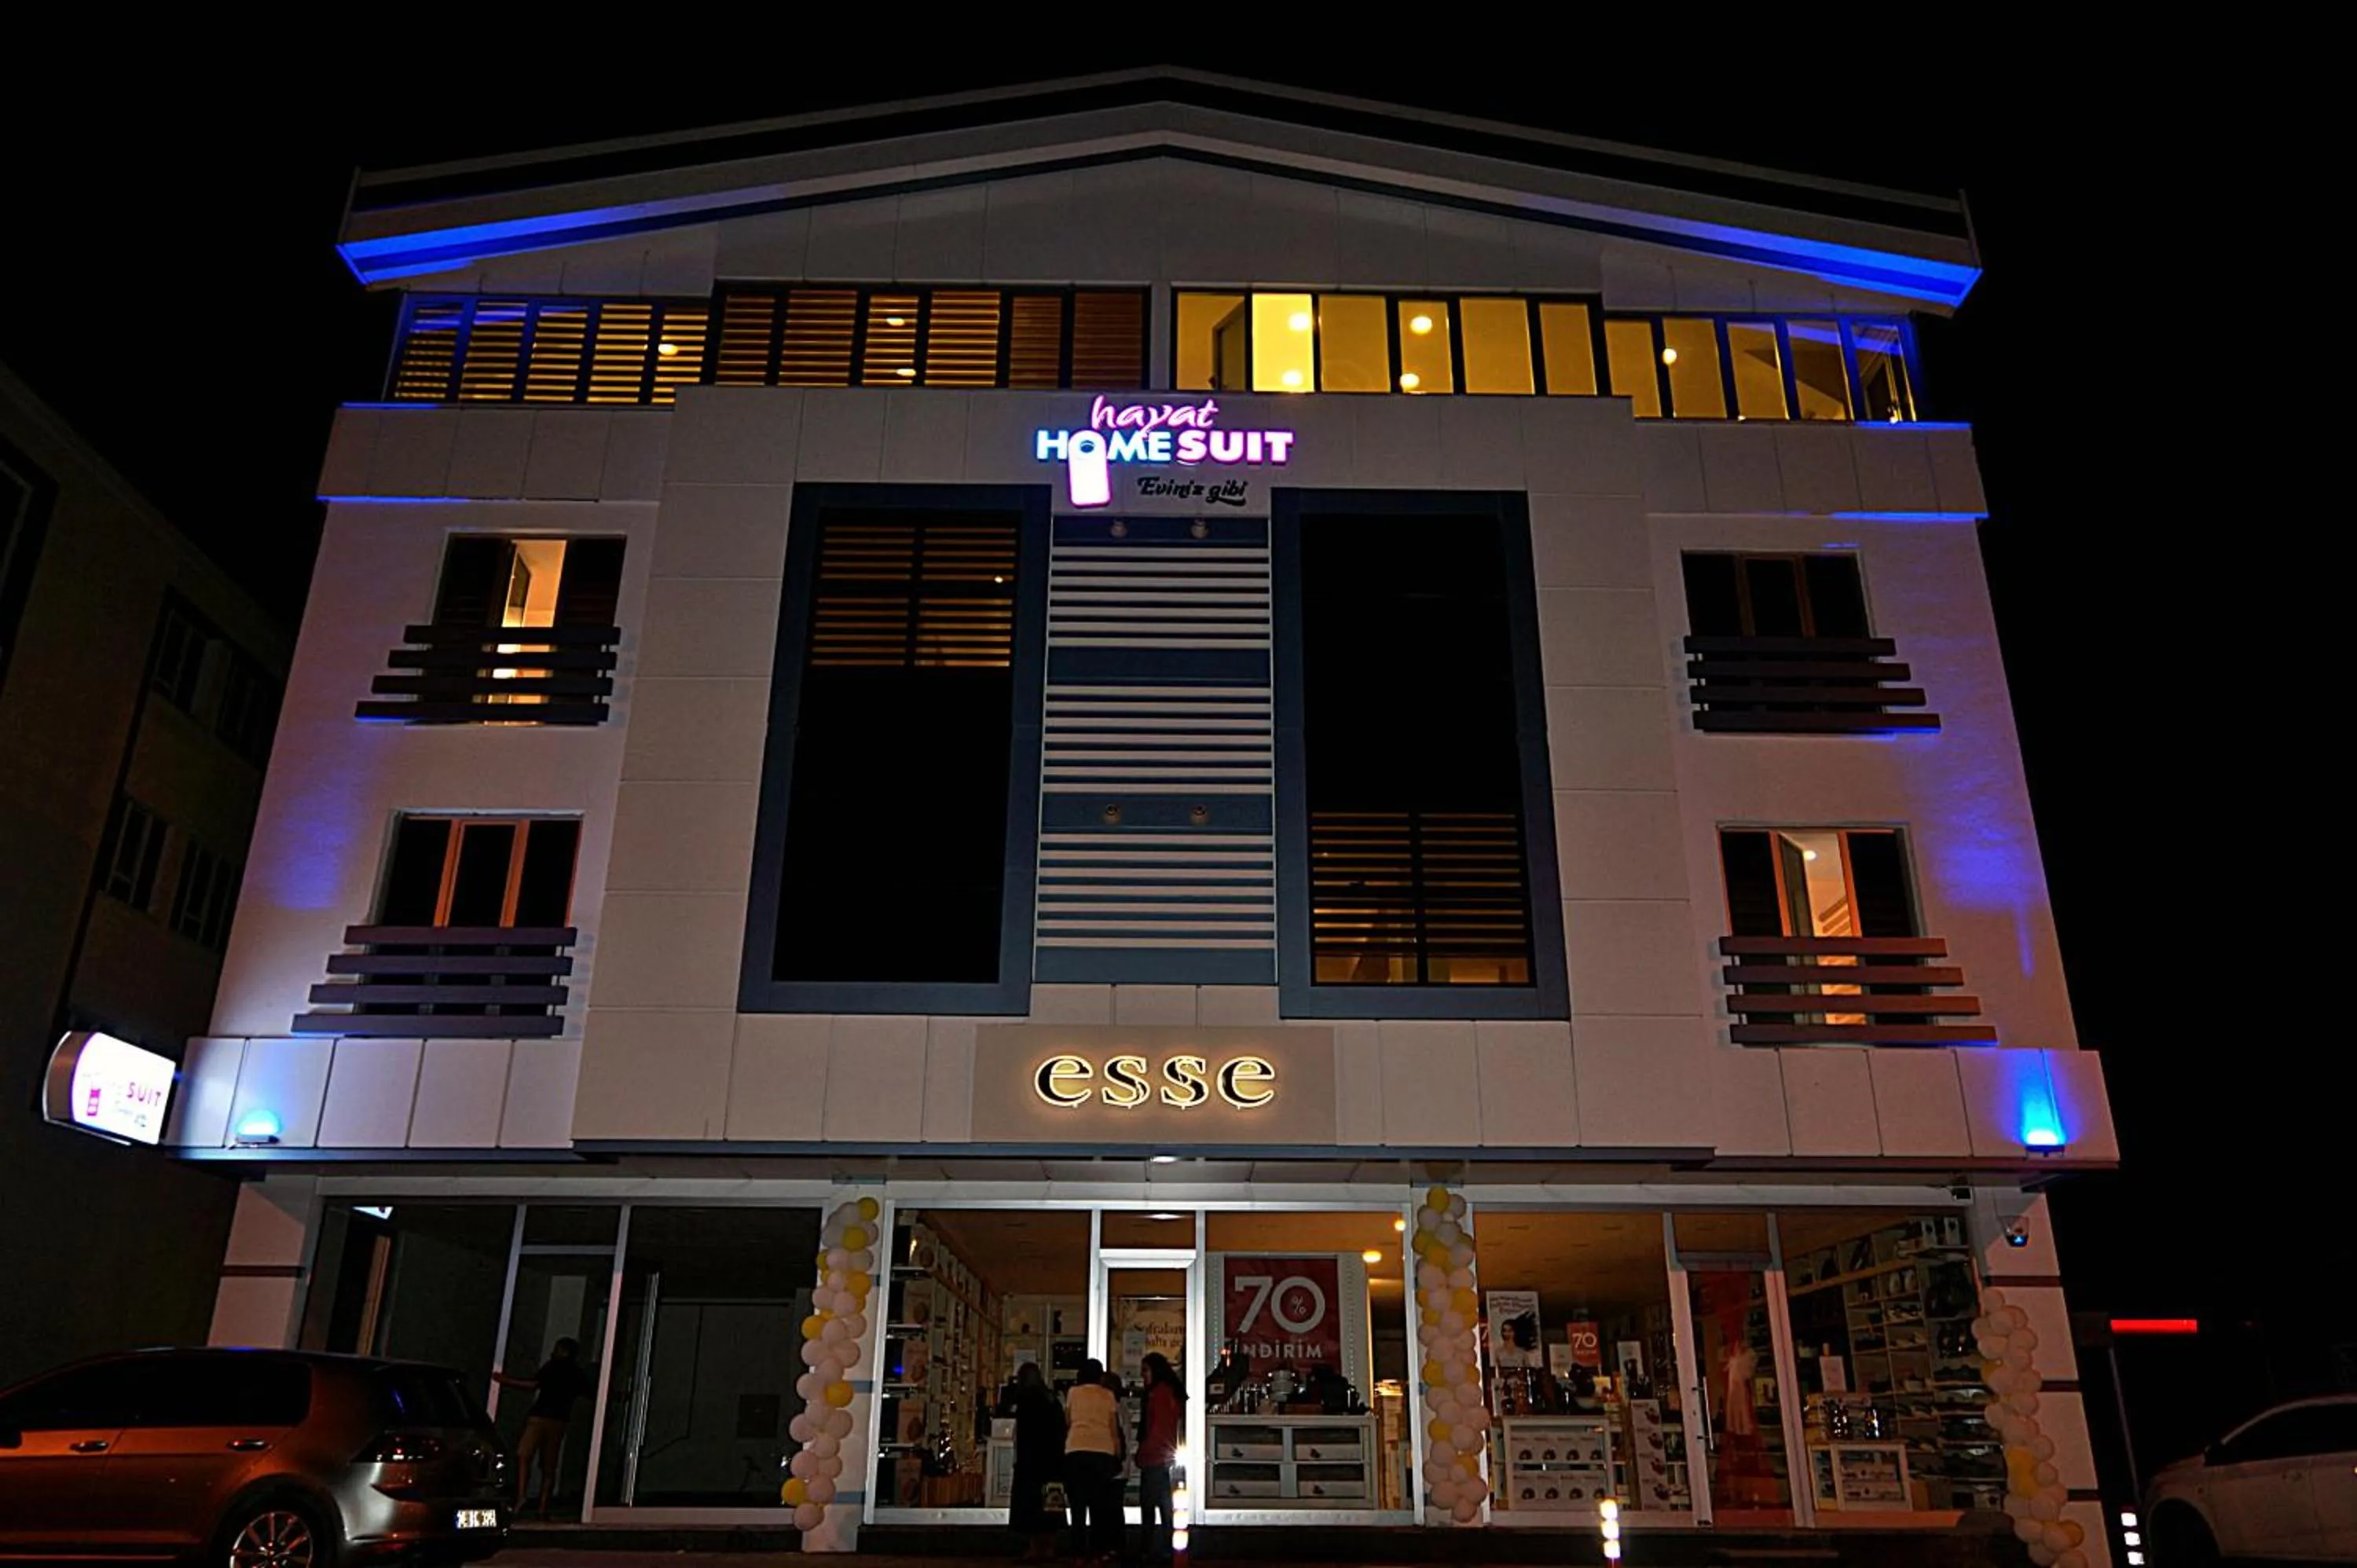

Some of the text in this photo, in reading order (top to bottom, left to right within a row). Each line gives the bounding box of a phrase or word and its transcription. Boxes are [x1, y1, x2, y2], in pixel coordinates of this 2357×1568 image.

[1091, 395, 1219, 441] hayat
[1036, 429, 1295, 465] HOME SUIT
[1205, 480, 1248, 507] gibi
[126, 1081, 162, 1107] SUIT
[1035, 1055, 1275, 1108] esse
[1234, 1275, 1326, 1334] 70
[1572, 1332, 1597, 1348] 70
